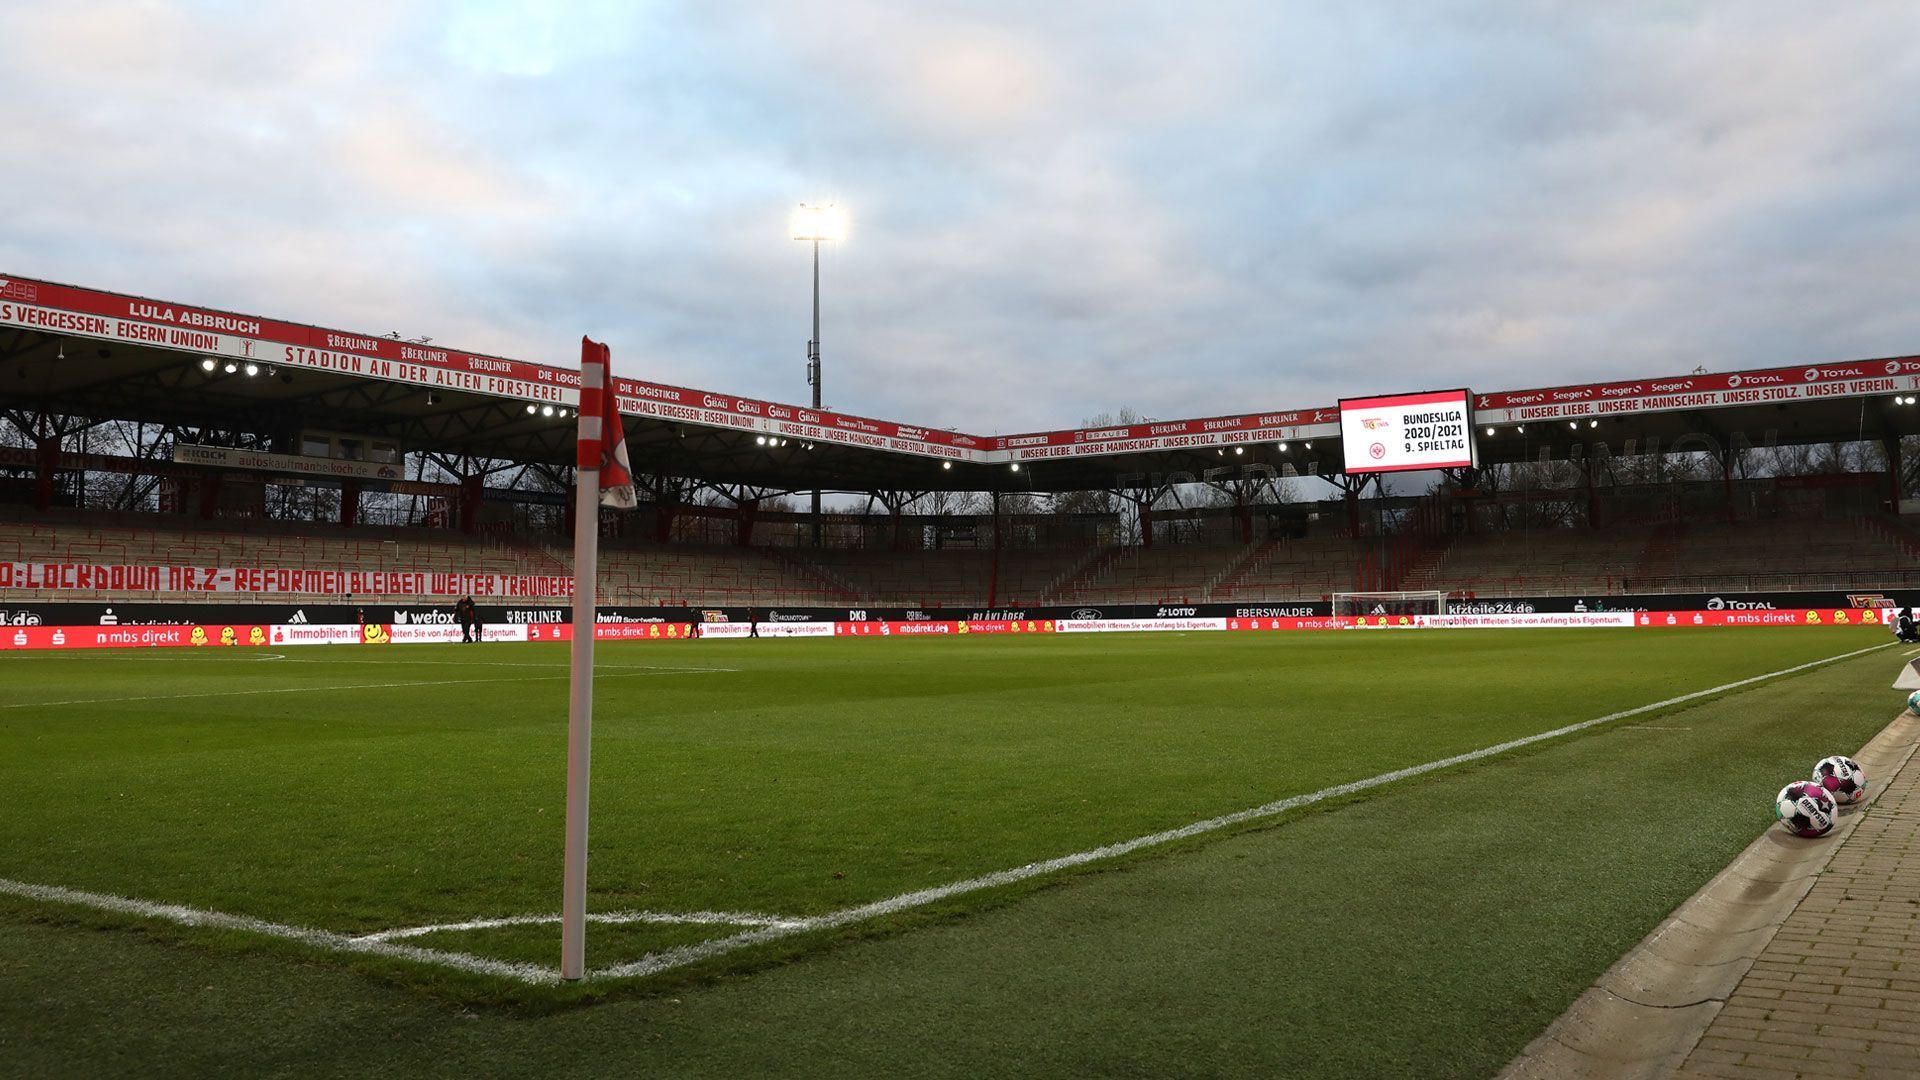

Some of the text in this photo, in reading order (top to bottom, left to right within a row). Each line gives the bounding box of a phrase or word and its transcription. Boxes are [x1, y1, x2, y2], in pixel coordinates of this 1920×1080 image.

[129, 303, 260, 334] LULA ABBRUCH
[17, 306, 110, 335] VERGESSEN:
[117, 321, 166, 343] EISERN
[170, 329, 219, 350] UNION!
[334, 335, 378, 351] BERLINER
[407, 347, 448, 363] BERLINER
[474, 358, 512, 373] BERLINER
[285, 346, 563, 401] STADION AN DER ALTEN FÖRSTEREI
[538, 370, 581, 386] DIE LOGIS
[1821, 368, 1863, 378] TOTAL
[1743, 375, 1784, 385] TOTAL
[619, 383, 680, 401] DIE LOGISTIKER
[1601, 386, 1633, 397] Seeger
[1651, 382, 1685, 392] Seeger
[1506, 395, 1537, 405] Seeger
[1521, 378, 1898, 419] UNSERE LIEBE. UNSERE MANNSCHAFT. UNSER STOLZ. UNSER VEREIN.
[1553, 391, 1584, 401] Seeger
[622, 398, 657, 414] NIEMALS
[658, 404, 702, 420] VERGESSEN:
[704, 411, 729, 424] EISERN
[730, 415, 755, 429] UNION!
[1264, 413, 1298, 425] BERLINER
[1403, 411, 1462, 425] BUNDESLIGA
[1155, 423, 1187, 434] BERLINER
[1208, 418, 1241, 430] BERLINER
[1404, 424, 1463, 440] 2020/2021
[779, 423, 803, 436] UNSERE
[804, 427, 823, 438] LIEBE.
[824, 430, 848, 442] UNSERE
[850, 433, 887, 448] MANNSCHAFT.
[890, 439, 909, 449] UNSER
[909, 441, 926, 452] STOLZ.
[927, 443, 943, 454] UNSER
[1021, 429, 1284, 459] UNSERE LIEBE. UNSERE MANNSCHAFT. UNSER STOLZ. UNSER VEREIN.
[1405, 439, 1465, 453] 9. SPIELTAG
[192, 450, 227, 460] KOCH
[351, 571, 424, 595] BLEIBEN
[432, 574, 494, 595] WEITER
[500, 575, 574, 596] TRÄUMERE
[1449, 602, 1533, 614] kfzteile24.de
[1726, 601, 1776, 610] TOTAL
[411, 609, 456, 624] wefox
[514, 610, 563, 624] BERLINER
[596, 612, 622, 623] bwin
[849, 610, 867, 621] DKB
[1168, 608, 1195, 616] LOTTO
[1236, 608, 1313, 618] EBERSWALDER
[1737, 613, 1760, 623] mbs
[1763, 613, 1795, 623] direkt
[1067, 621, 1106, 629] Immobilien
[1305, 620, 1322, 628] mbs
[1511, 617, 1522, 625] Sie
[1540, 616, 1567, 626] Anfang
[1569, 616, 1581, 624] bis
[290, 627, 348, 639] Immobilien
[415, 629, 425, 638] Sie
[443, 628, 464, 638] Anfan
[483, 629, 518, 639] Eigentum.
[604, 627, 620, 636] mbs
[622, 627, 644, 636] direkt
[706, 625, 741, 634] Immobilien
[110, 631, 138, 643] mbs
[142, 630, 180, 643] direkt
